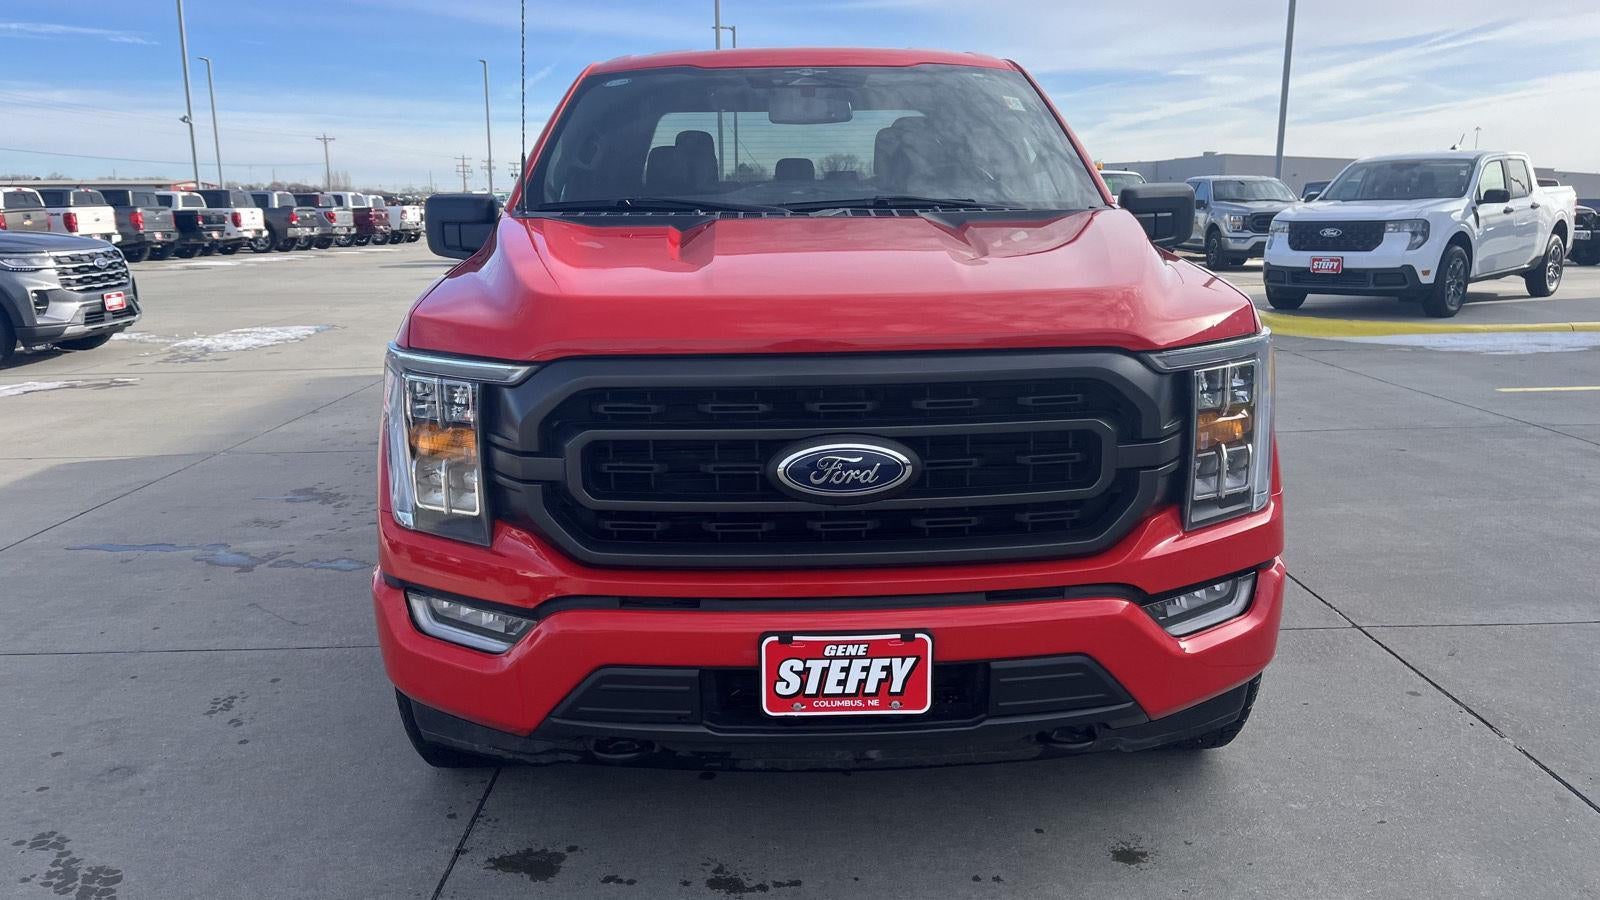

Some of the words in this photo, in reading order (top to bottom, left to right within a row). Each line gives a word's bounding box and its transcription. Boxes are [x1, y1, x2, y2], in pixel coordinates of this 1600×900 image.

[1313, 261, 1339, 269] STEFFY
[809, 455, 881, 485] Ford
[823, 643, 869, 657] GENE
[774, 656, 919, 697] STEFFY
[813, 699, 865, 708] COLUMBUS,
[867, 699, 880, 707] NE
